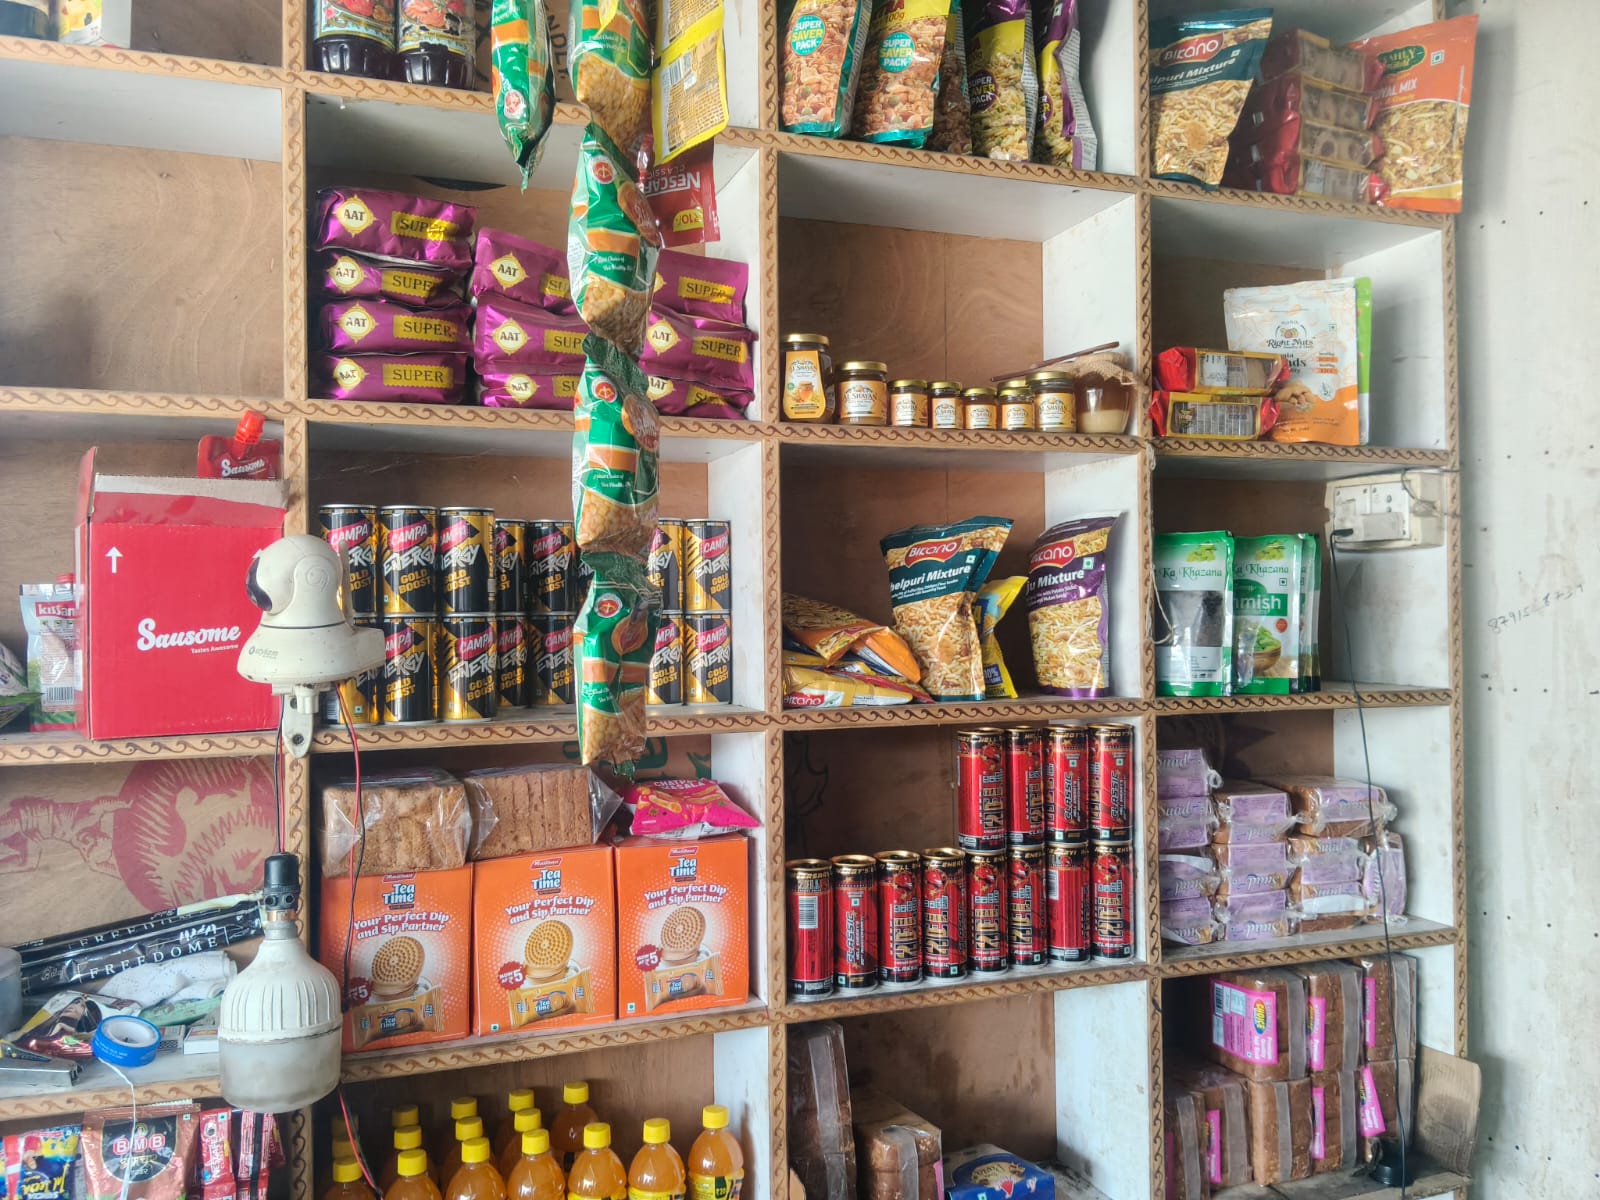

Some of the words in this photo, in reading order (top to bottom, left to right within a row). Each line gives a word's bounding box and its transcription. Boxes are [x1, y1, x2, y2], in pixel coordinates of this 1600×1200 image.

[795, 20, 822, 30] SUPER
[792, 28, 823, 41] SAVER
[882, 38, 911, 48] SUPER
[796, 39, 817, 50] PACK
[881, 47, 914, 58] SAVER
[883, 58, 907, 67] PACK
[1186, 57, 1236, 78] Mixture
[971, 85, 996, 97] AVER
[644, 171, 701, 194] NESCAF
[343, 208, 366, 223] AAT
[335, 266, 356, 279] AAT
[392, 274, 433, 292] SUPE
[496, 263, 519, 277] AAT
[346, 316, 368, 328] AAT
[402, 321, 452, 338] SUPER
[499, 331, 521, 343] AAT
[553, 336, 582, 350] SUP
[651, 329, 671, 342] AAT
[700, 340, 743, 358] SUPER
[392, 369, 445, 384] SUPER
[221, 458, 265, 477] Sausome
[330, 523, 369, 546] CAMPA
[391, 523, 428, 546] CAMPA
[440, 524, 468, 545] AMPA
[532, 534, 562, 554] CAMPA
[440, 544, 481, 571] ERGY
[693, 552, 730, 580] ENER
[400, 568, 428, 584] GOLD
[890, 572, 926, 592] helpuri
[926, 564, 972, 582] Mixture
[1037, 568, 1085, 588] Mixture
[1181, 565, 1222, 580] Khazana
[1245, 563, 1289, 579] Khazana
[398, 576, 431, 594] BOOST
[446, 575, 471, 592] OOST
[710, 581, 730, 595] BOOS
[1234, 593, 1281, 610] mish
[136, 618, 241, 651] Sausome
[385, 631, 412, 652] AMPA
[458, 631, 494, 653] CAMPA
[498, 628, 523, 647] AMPA
[656, 626, 675, 644] MPA
[699, 626, 728, 646] CAMPA
[385, 650, 425, 680] ERGY
[536, 646, 574, 673] ENER
[690, 645, 731, 673] ENERG
[447, 653, 498, 684] ENERG
[553, 667, 573, 680] GOL
[652, 665, 675, 679] GOLD
[707, 664, 728, 679] GOLD
[386, 676, 412, 692] GOLD
[469, 675, 493, 691] GOLD
[551, 676, 572, 689] BOO
[705, 670, 729, 687] BOOST
[466, 682, 495, 701] BOOST
[669, 866, 697, 877] Time
[677, 857, 697, 868] Tea
[541, 868, 561, 880] Tea
[393, 883, 415, 894] Tea
[531, 878, 561, 890] Time
[643, 888, 669, 900] Your
[670, 884, 707, 895] Perfect
[709, 884, 727, 895] Dip
[382, 892, 415, 904] Time
[504, 901, 532, 916] Your
[533, 896, 574, 907] Perfect
[575, 896, 595, 907] Dip
[647, 898, 667, 909] and
[668, 894, 684, 906] Sip
[685, 893, 724, 903] Partner
[353, 915, 383, 930] Your
[384, 911, 427, 924] Perfect
[429, 911, 449, 924] Dip
[509, 911, 530, 925] and
[531, 908, 548, 919] Sip
[549, 906, 591, 916] Partner
[357, 927, 379, 940] and
[381, 924, 399, 936] Sip
[401, 922, 445, 932] Partner
[846, 911, 856, 963] CLASSIC
[89, 937, 219, 979] FREEDOME
[112, 1133, 166, 1156] BMB
